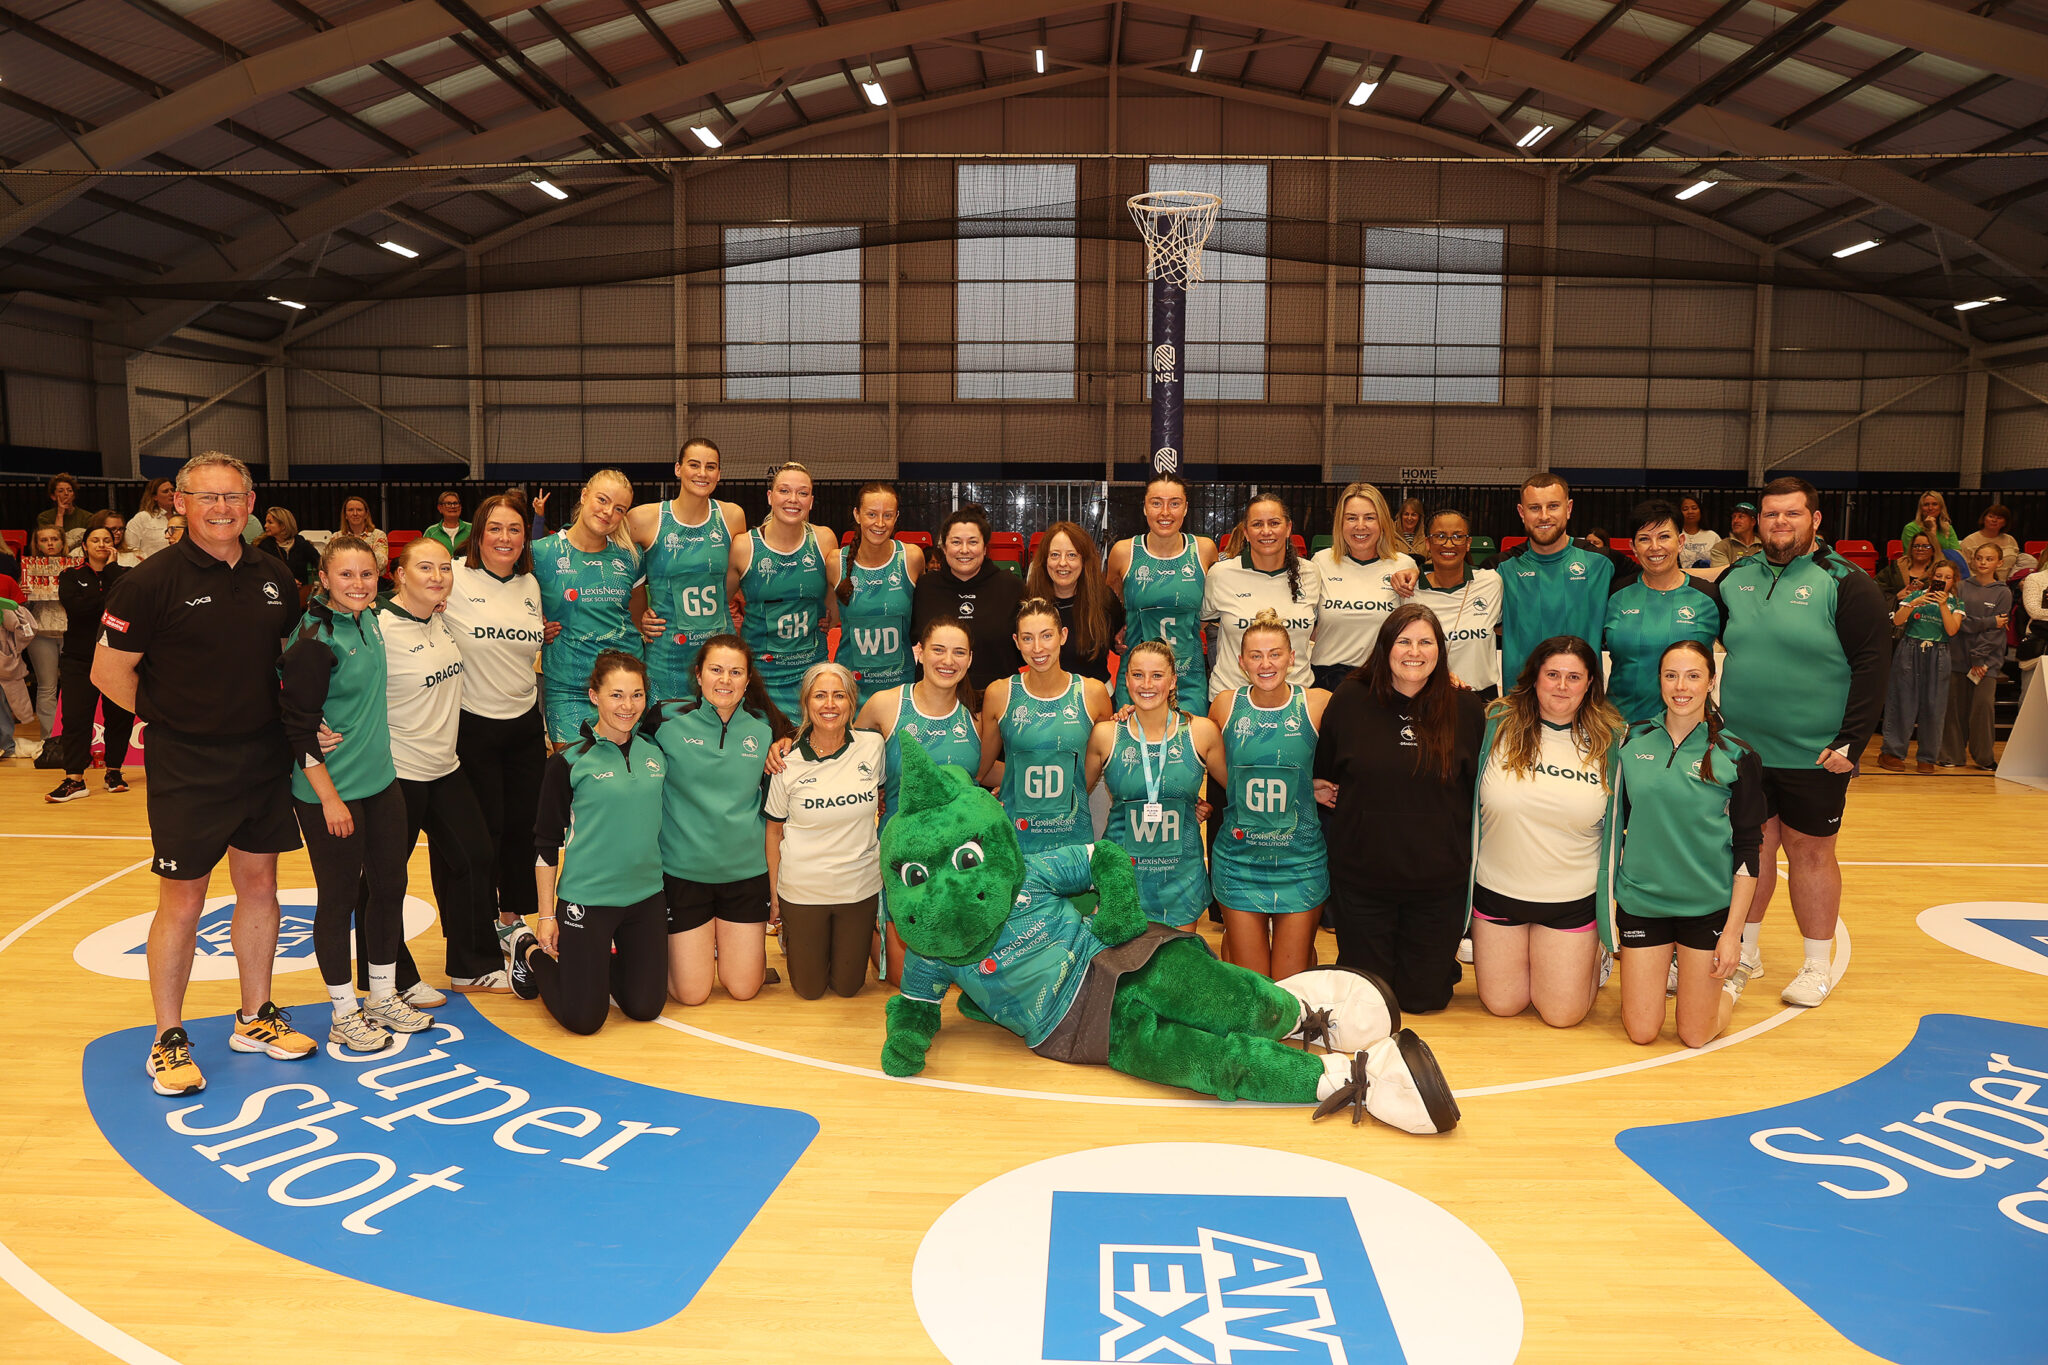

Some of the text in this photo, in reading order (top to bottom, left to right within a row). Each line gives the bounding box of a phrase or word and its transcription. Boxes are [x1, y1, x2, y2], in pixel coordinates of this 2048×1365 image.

[1155, 372, 1178, 383] NSL
[1401, 469, 1438, 479] HOME
[580, 587, 626, 596] LexisNexis
[682, 585, 718, 616] GS
[1323, 599, 1395, 612] DRAGONS
[473, 627, 544, 643] DRAGONS
[777, 611, 809, 639] GK
[1237, 618, 1311, 629] DONS
[854, 627, 899, 656] WD
[1024, 765, 1064, 799] GD
[1246, 778, 1287, 813] GA
[803, 791, 875, 809] DRAGONS
[1031, 818, 1076, 828] LexisNexis
[1130, 809, 1180, 843] WA
[1138, 857, 1179, 865] LexisNexis
[993, 918, 1047, 960] LexisNexis
[1002, 931, 1049, 968] RISK SOLUTIONS
[327, 1023, 681, 1171] Super
[1749, 1053, 2048, 1200] Super
[166, 1083, 465, 1235] Shot
